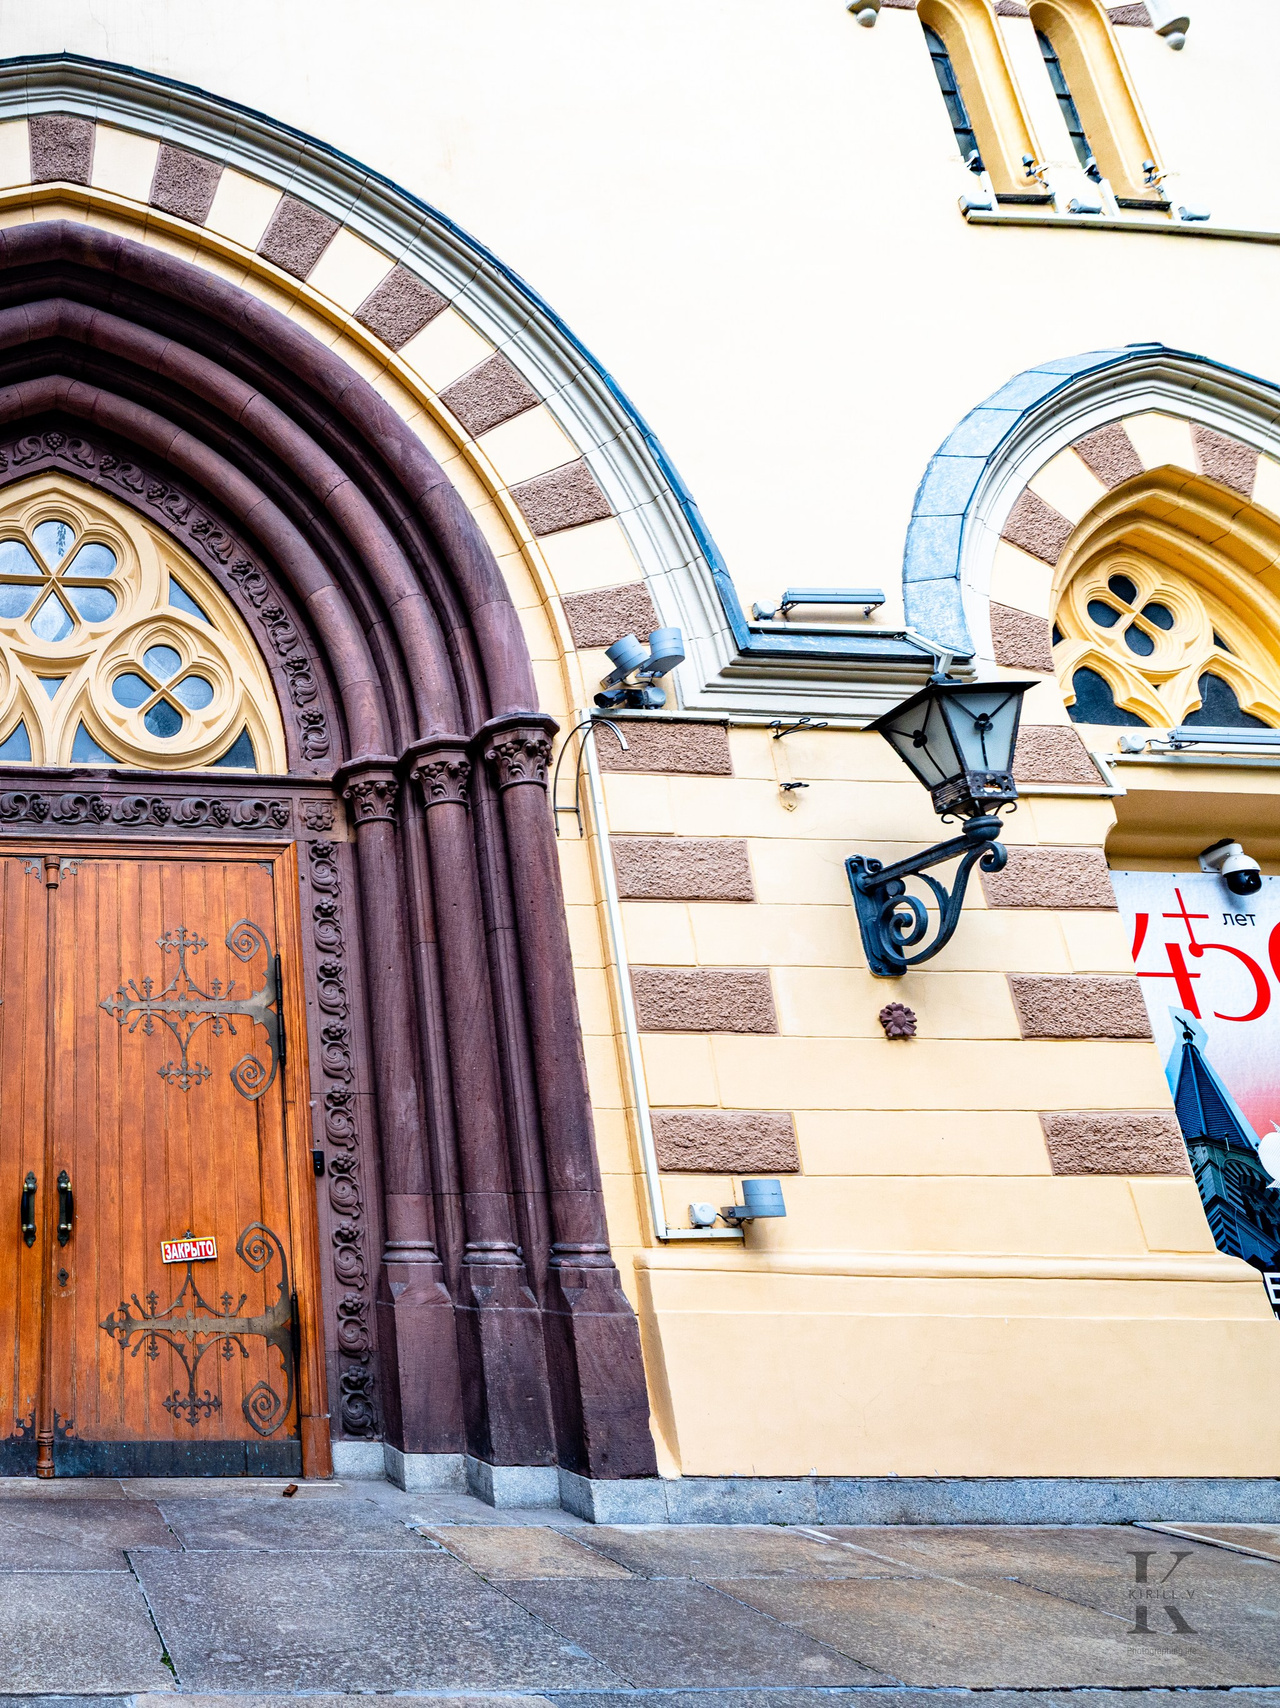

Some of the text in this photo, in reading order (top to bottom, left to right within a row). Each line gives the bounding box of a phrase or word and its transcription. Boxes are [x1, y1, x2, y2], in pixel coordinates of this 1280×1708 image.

[1223, 913, 1256, 926] лет
[1131, 888, 1280, 1022] 45
[164, 1240, 214, 1260] ЗАКРЫТО
